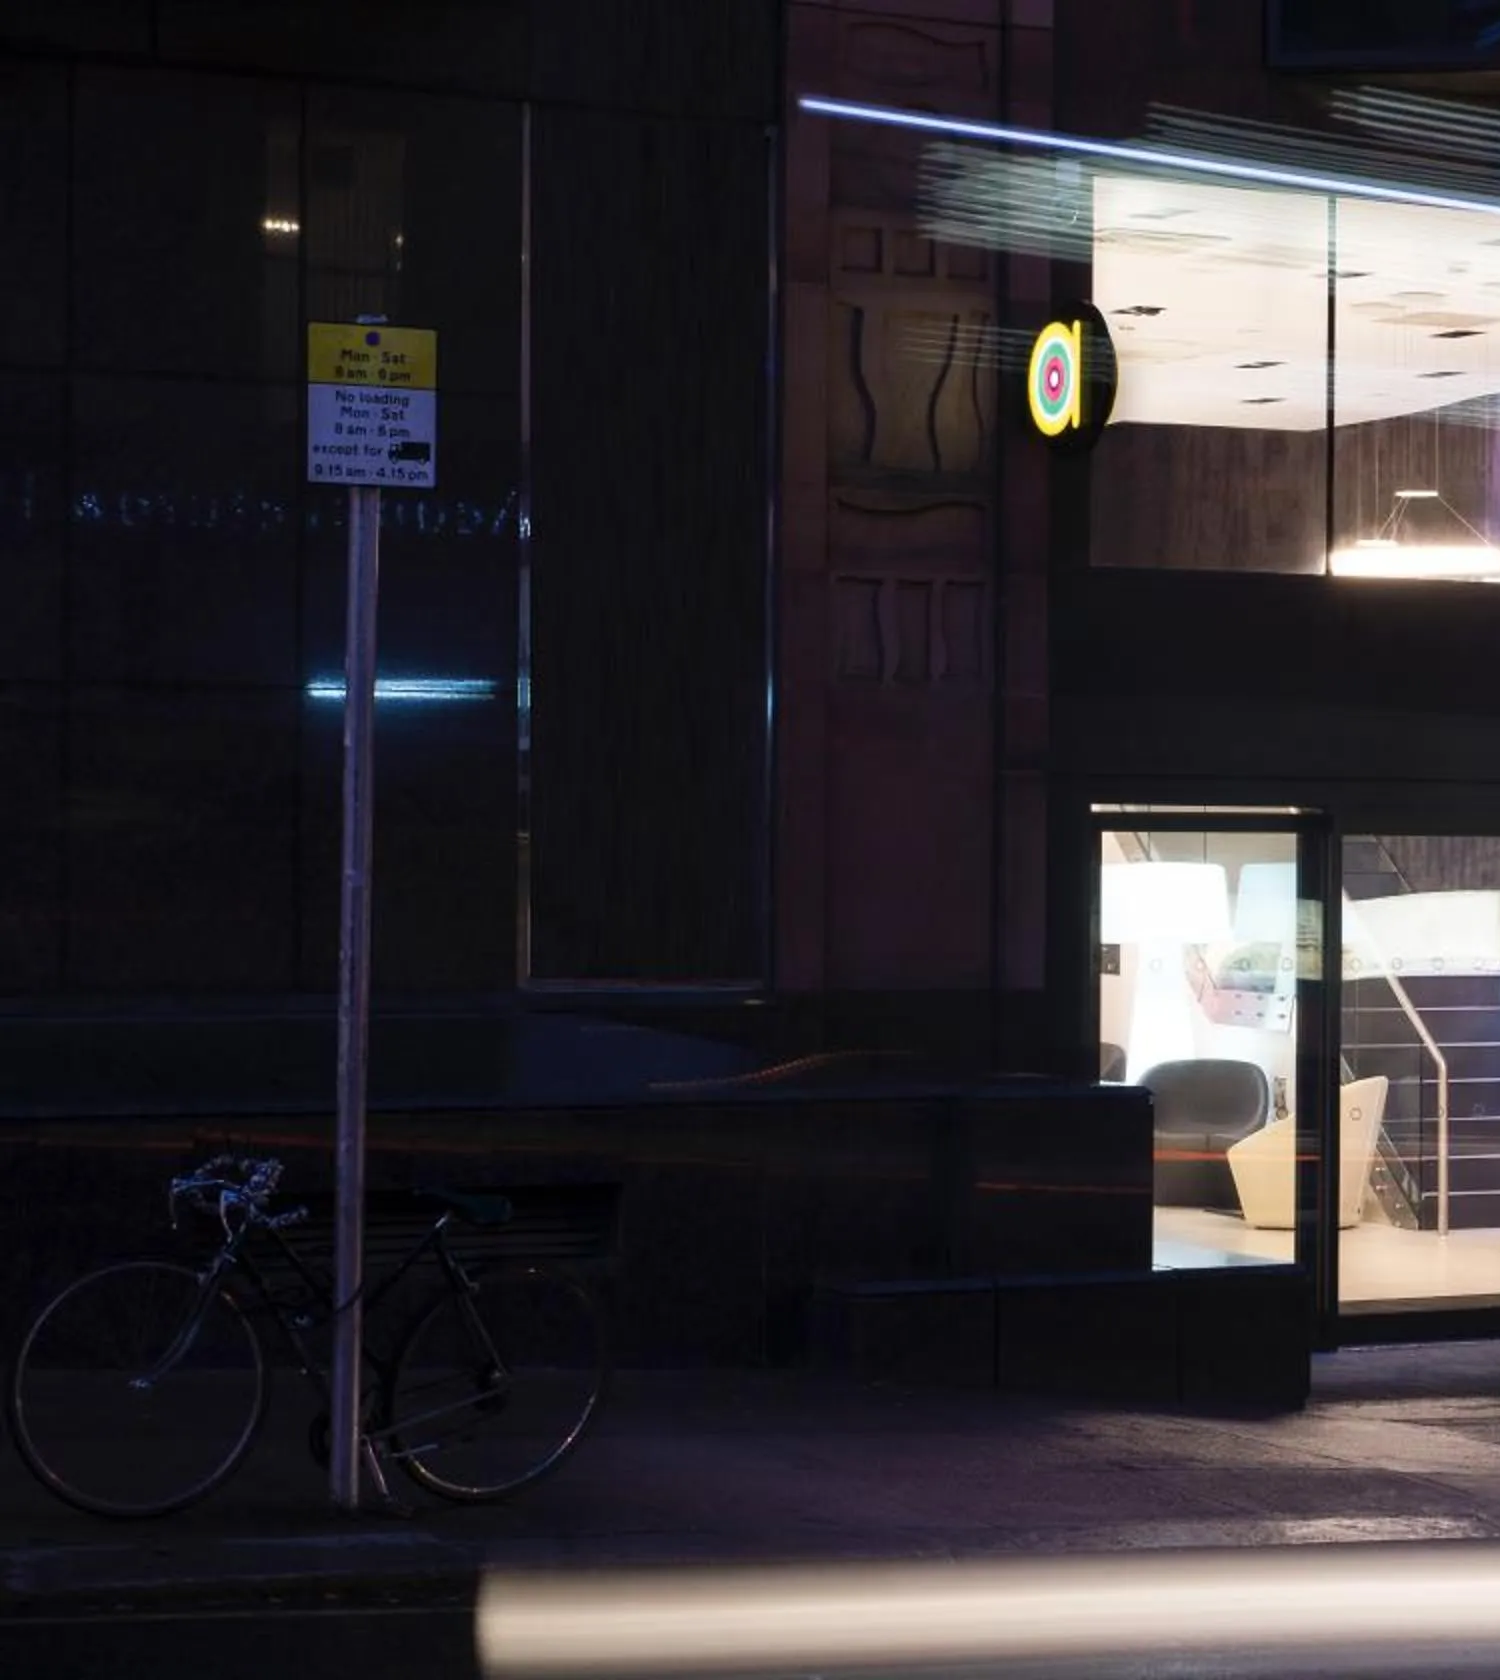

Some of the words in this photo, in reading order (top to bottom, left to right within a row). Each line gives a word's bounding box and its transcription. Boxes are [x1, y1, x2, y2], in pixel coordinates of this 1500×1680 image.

[341, 349, 370, 363] Mon
[381, 352, 406, 365] Sat
[335, 390, 355, 402] No
[360, 392, 411, 408] loading
[341, 406, 370, 418] Mon
[381, 408, 405, 421] Sat
[313, 444, 357, 457] except
[365, 444, 383, 457] for
[346, 466, 367, 478] am
